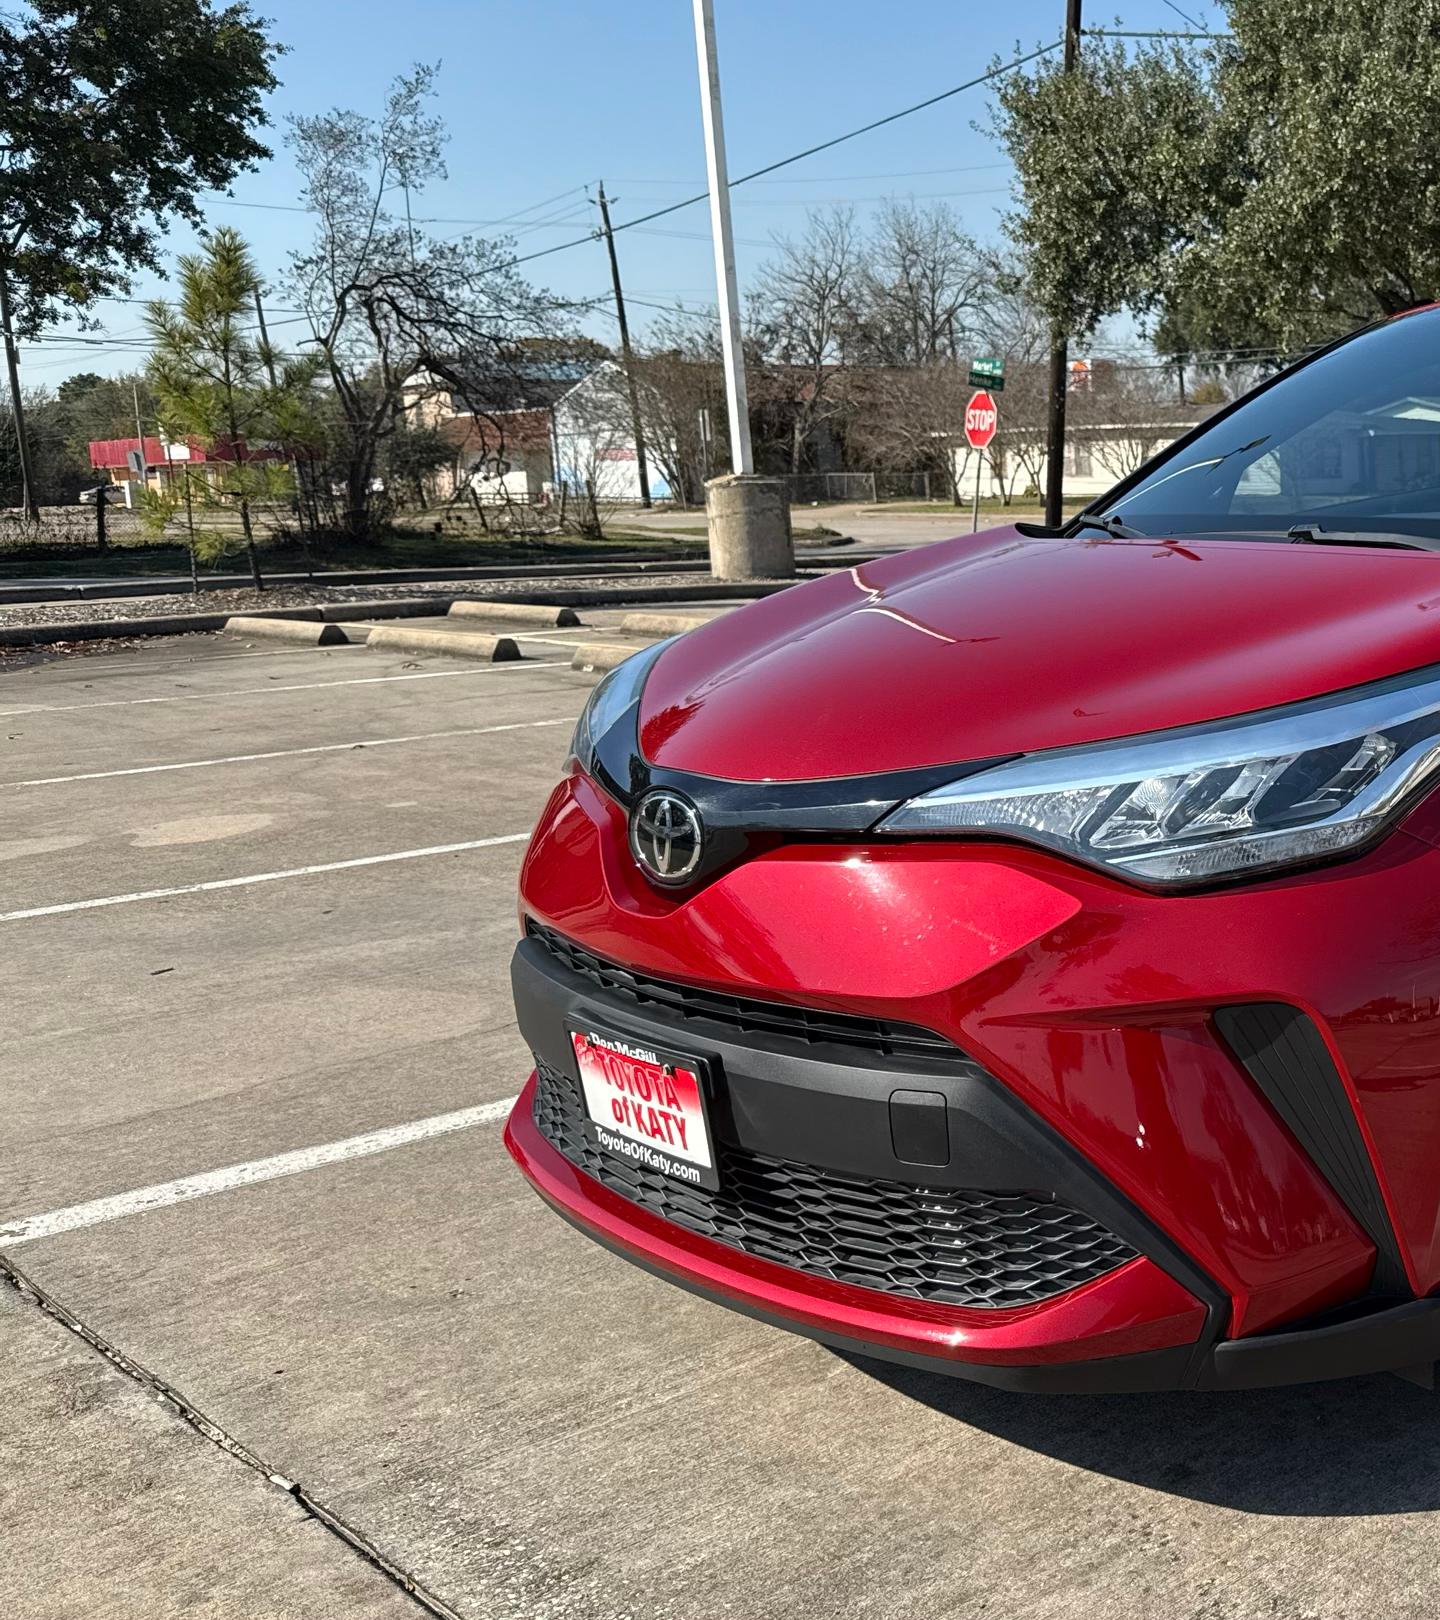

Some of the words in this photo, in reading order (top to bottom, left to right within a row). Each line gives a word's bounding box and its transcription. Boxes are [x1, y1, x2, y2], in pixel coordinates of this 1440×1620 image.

[967, 409, 995, 431] STOP
[614, 1041, 661, 1066] McGill
[596, 1052, 683, 1112] TOYOTA
[611, 1095, 632, 1128] of
[631, 1099, 689, 1151] KATY
[595, 1125, 701, 1183] ToyotaOfKaty.com
